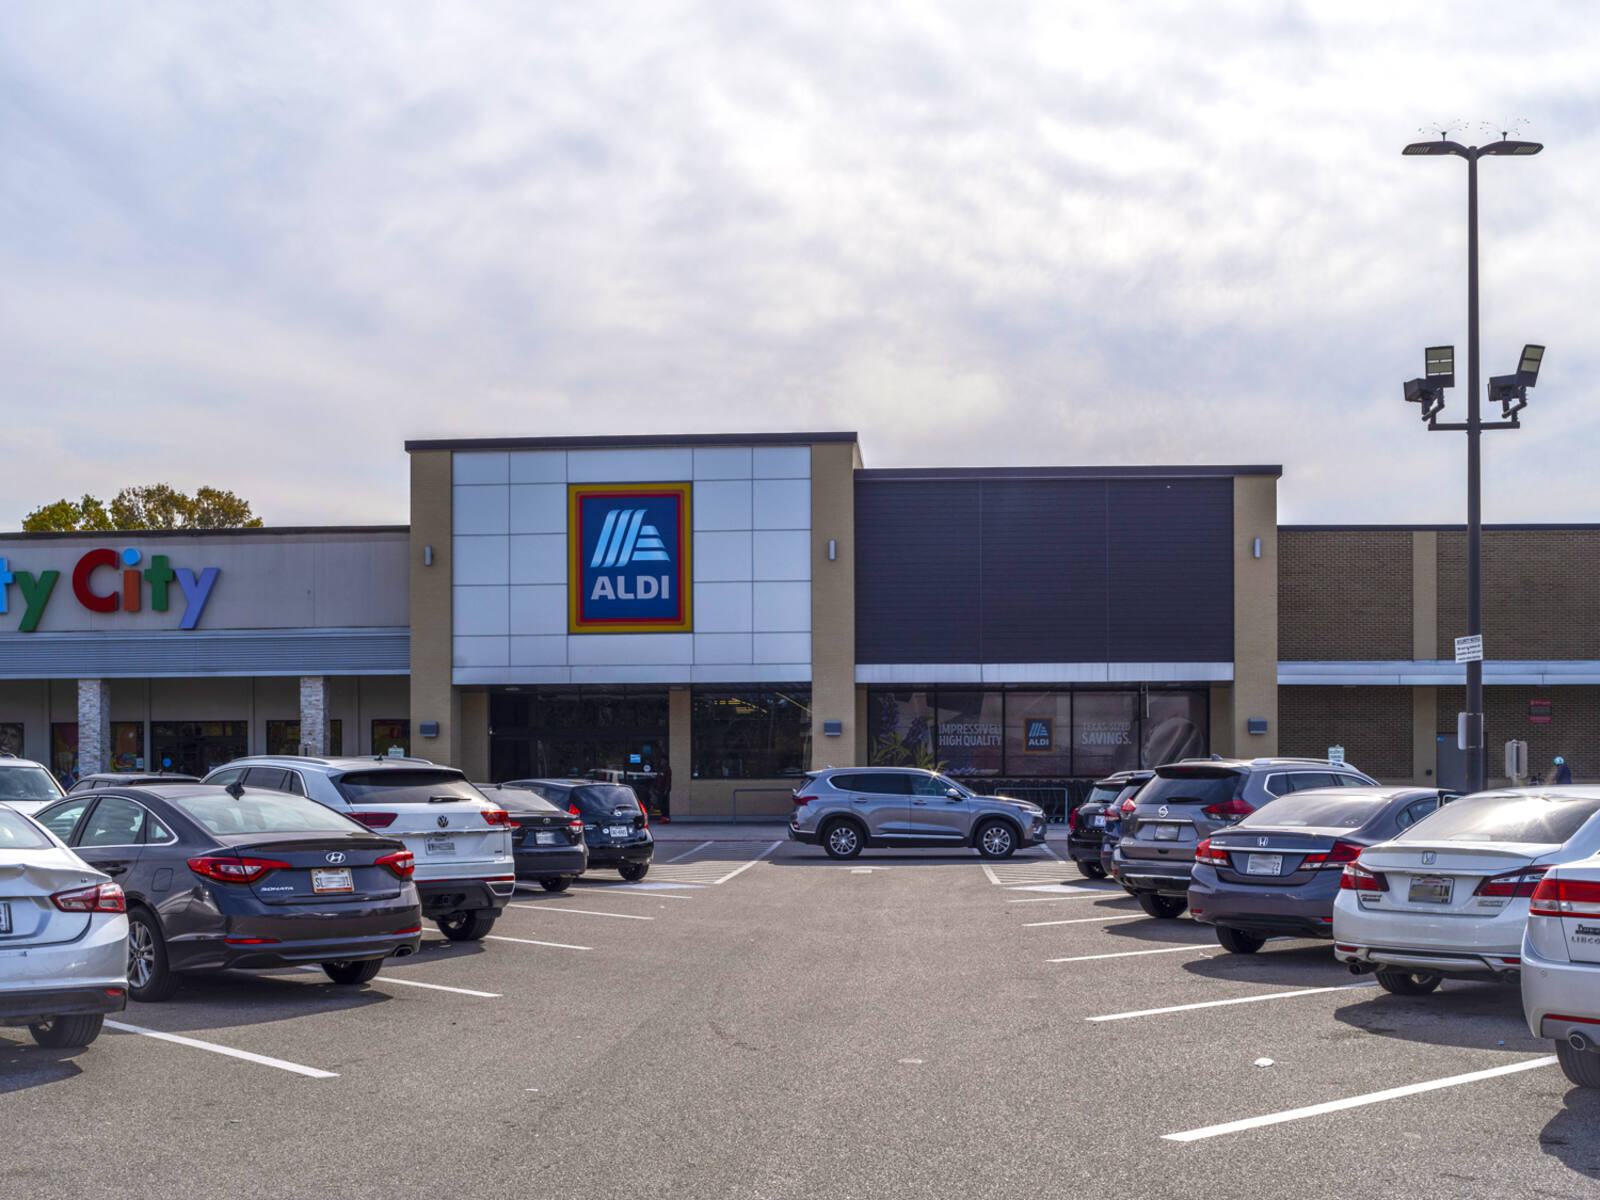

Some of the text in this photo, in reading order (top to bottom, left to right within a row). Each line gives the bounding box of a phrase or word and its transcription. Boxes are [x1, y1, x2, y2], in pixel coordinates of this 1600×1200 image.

[72, 548, 220, 630] City
[590, 575, 670, 600] ALDI
[939, 735, 1002, 747] HIGH QUALITY
[1028, 738, 1050, 746] ALDI
